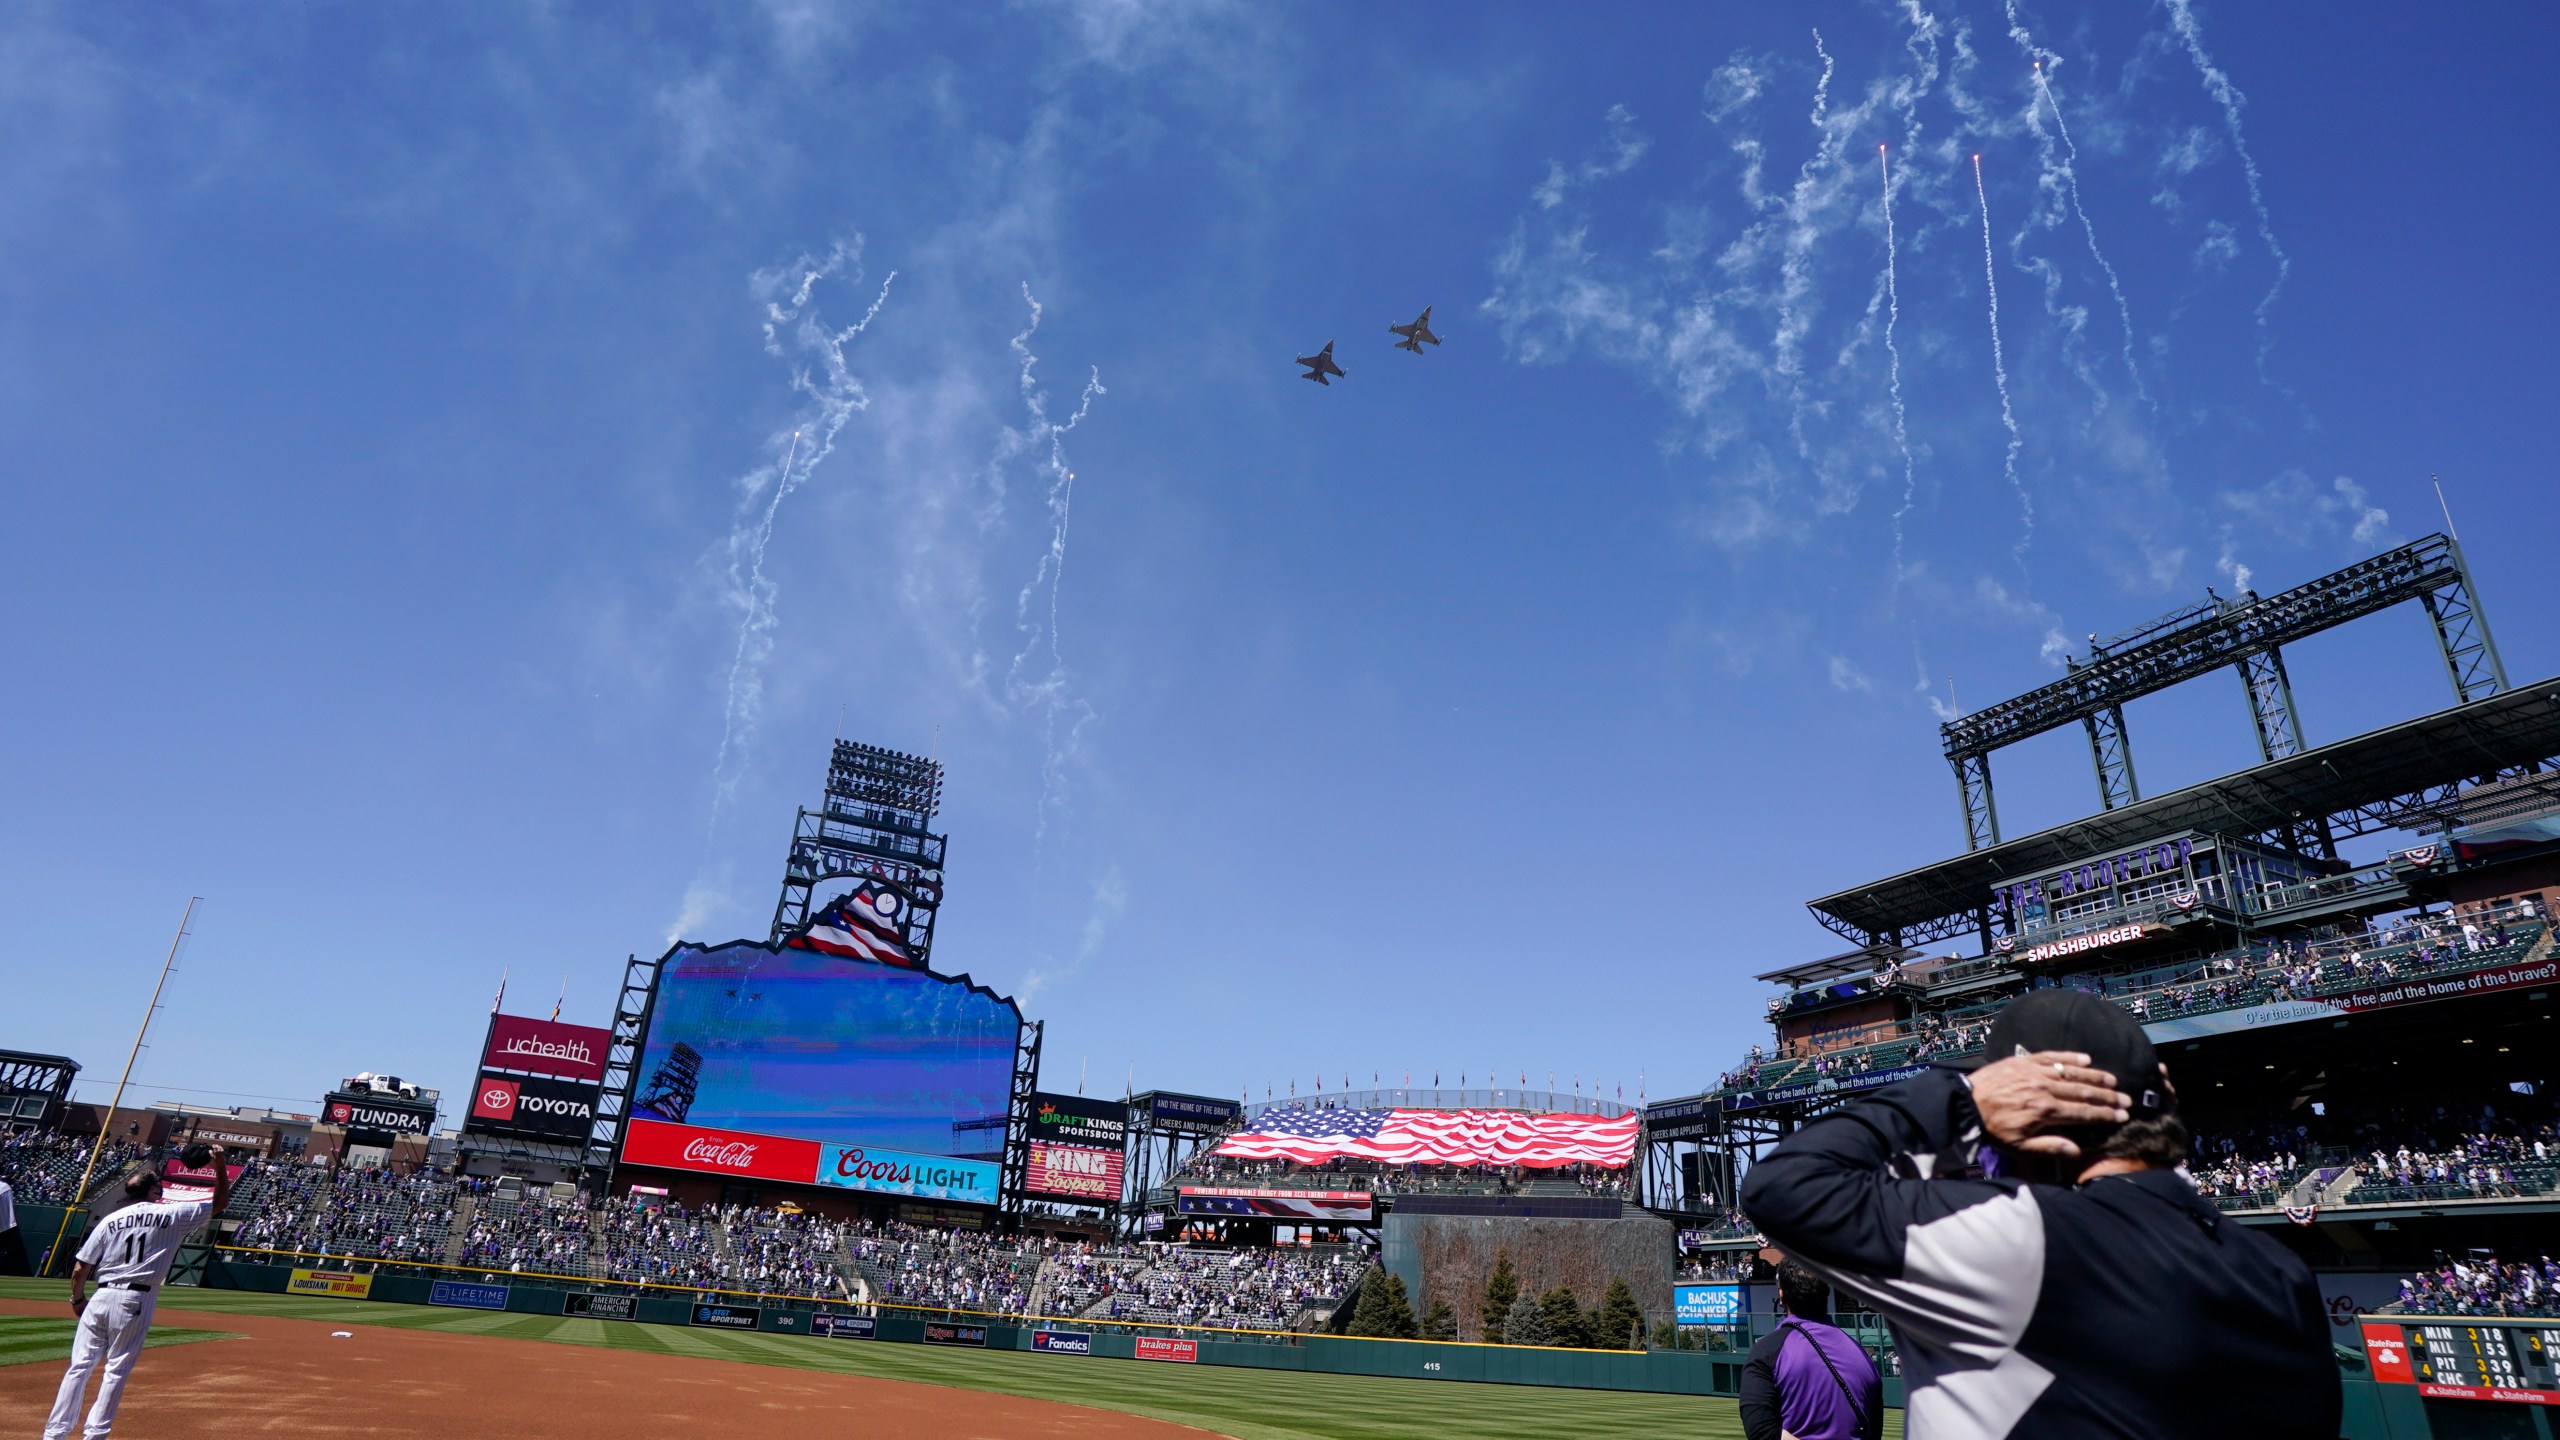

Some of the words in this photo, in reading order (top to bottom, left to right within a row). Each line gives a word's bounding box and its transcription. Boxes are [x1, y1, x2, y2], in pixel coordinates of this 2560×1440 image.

[792, 842, 945, 904] ROCKIES
[1994, 879, 2045, 913] THE
[2060, 837, 2194, 896] ROOFTOP
[2028, 925, 2144, 962] SMASHBURGER
[2272, 1006, 2290, 1021] the
[2291, 1002, 2316, 1019] land
[2318, 999, 2331, 1015] of
[2330, 996, 2351, 1012] the
[2352, 992, 2377, 1008] free
[2379, 989, 2403, 1005] and
[2405, 985, 2426, 1001] the
[2428, 979, 2466, 997] home
[2467, 976, 2482, 990] of
[2484, 972, 2507, 988] the
[2509, 963, 2558, 984] brave?
[506, 1034, 590, 1062] uchealth
[1781, 1088, 1792, 1098] the
[1792, 1085, 1807, 1097] land
[1814, 1083, 1825, 1094] the
[1825, 1081, 1839, 1092] free
[1839, 1079, 1853, 1090] and
[1853, 1076, 1865, 1088] the
[1865, 1074, 1885, 1086] home
[1893, 1070, 1905, 1081] the
[425, 1091, 438, 1100] 485
[519, 1095, 591, 1118] TOYOTA
[1157, 1099, 1169, 1109] AND
[1169, 1100, 1179, 1110] THE
[1180, 1102, 1195, 1112] HOME
[1203, 1105, 1213, 1115] THE
[1214, 1106, 1231, 1117] BRAVE
[351, 1108, 420, 1129] TUNDRA
[1040, 1112, 1124, 1131] DRAFTKINGS
[1160, 1118, 1182, 1129] CHEERS
[1183, 1121, 1195, 1131] AND
[197, 1131, 217, 1140] ICE
[218, 1133, 258, 1144] CREAM
[1059, 1125, 1122, 1141] SPORTSBOOK
[1651, 1128, 1669, 1141] CHEERS
[1669, 1126, 1680, 1138] AND
[1680, 1124, 1704, 1137] APPLAUSE
[1045, 1147, 1107, 1175] KING
[837, 1149, 911, 1184] Coors
[914, 1166, 978, 1190] LIGHT
[1041, 1169, 1106, 1195] Soopers
[1194, 1187, 1218, 1196] POWERED
[1227, 1188, 1257, 1197] RENEWABLE
[1257, 1189, 1277, 1197] ENERGY
[1278, 1190, 1293, 1198] FROM
[1308, 1191, 1328, 1199] ENERGY
[108, 1213, 172, 1234] REDMOND
[124, 1232, 147, 1264] 11
[332, 1282, 345, 1292] HOT
[345, 1284, 367, 1294] SAUCE
[451, 1288, 504, 1300] LIFETIME
[592, 1296, 631, 1306] AMERICAN
[1688, 1291, 1727, 1305] BACHUS
[590, 1303, 629, 1313] FINANCING
[712, 1309, 730, 1317] AT&T
[1677, 1305, 1727, 1318] SCHANKER
[710, 1315, 753, 1325] SPORTSNET
[778, 1316, 794, 1325] 390
[849, 1320, 871, 1328] SPORTS
[927, 1326, 955, 1340] Exxon
[957, 1328, 984, 1341] Mobil
[2414, 1332, 2424, 1346] 4
[2425, 1326, 2453, 1340] MIN
[2467, 1327, 2478, 1341] 3
[2530, 1336, 2542, 1350] 3
[1049, 1338, 1088, 1351] Fanatics
[1140, 1339, 1171, 1350] brakes
[1173, 1341, 1193, 1352] plus
[2429, 1341, 2454, 1354] MIL
[2472, 1342, 2481, 1355] 1
[1424, 1362, 1440, 1371] 415
[2422, 1363, 2432, 1376] 4
[2436, 1357, 2456, 1371] PIT
[2477, 1359, 2487, 1372] 3
[2437, 1372, 2465, 1386] CHC
[2481, 1374, 2492, 1388] 2
